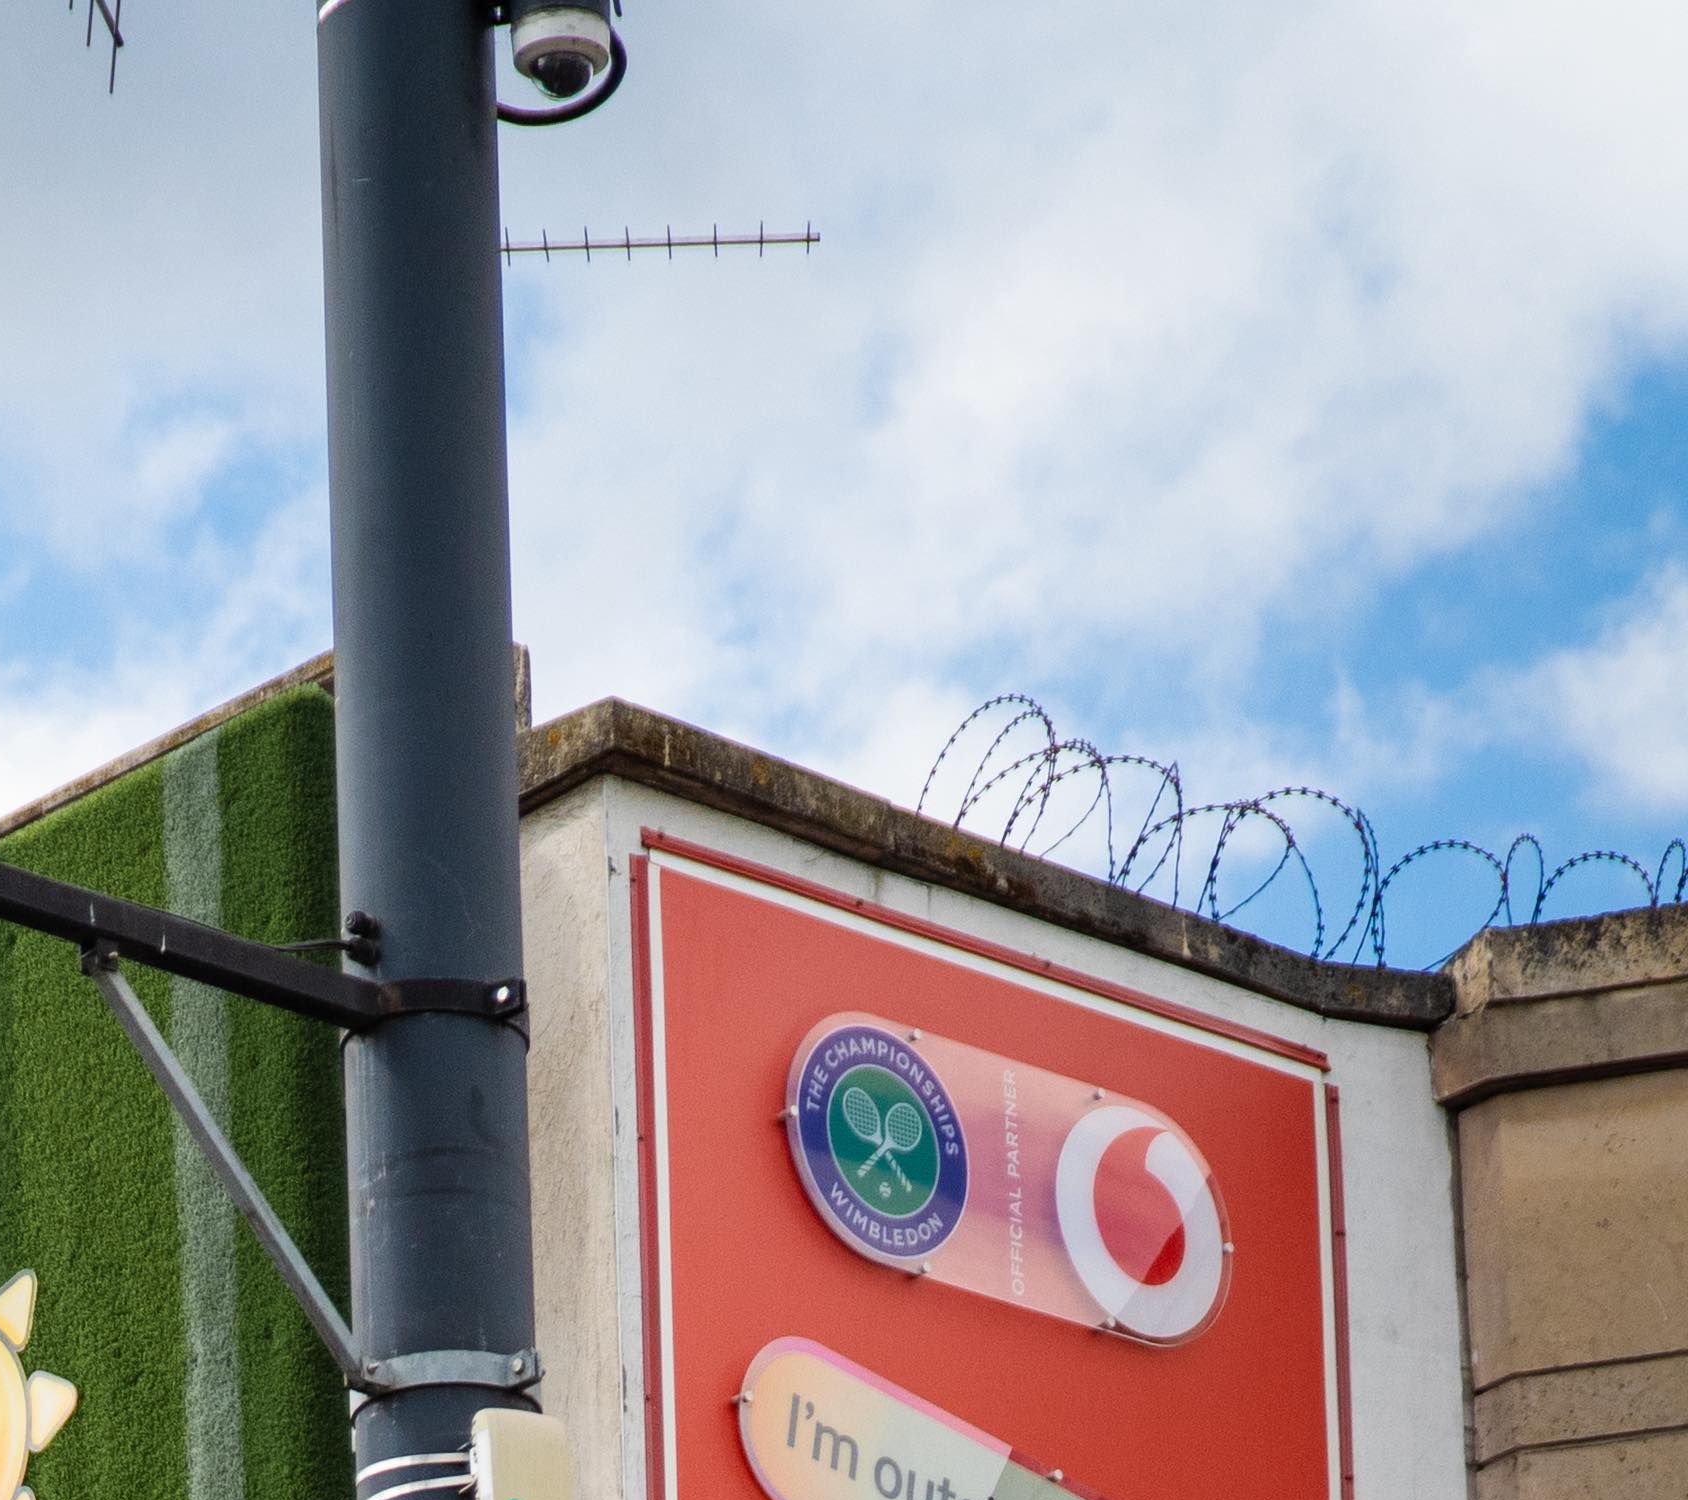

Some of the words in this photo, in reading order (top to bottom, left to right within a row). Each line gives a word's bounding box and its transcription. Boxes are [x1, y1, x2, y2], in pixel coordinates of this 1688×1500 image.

[805, 1062, 829, 1110] THE
[826, 1036, 959, 1157] CHAMPIONSHIPS
[1005, 1070, 1020, 1182] PARTNER
[828, 1181, 944, 1248] WIMBLEDON
[1006, 1186, 1026, 1296] OFFICIAL
[787, 1392, 858, 1480] I'm
